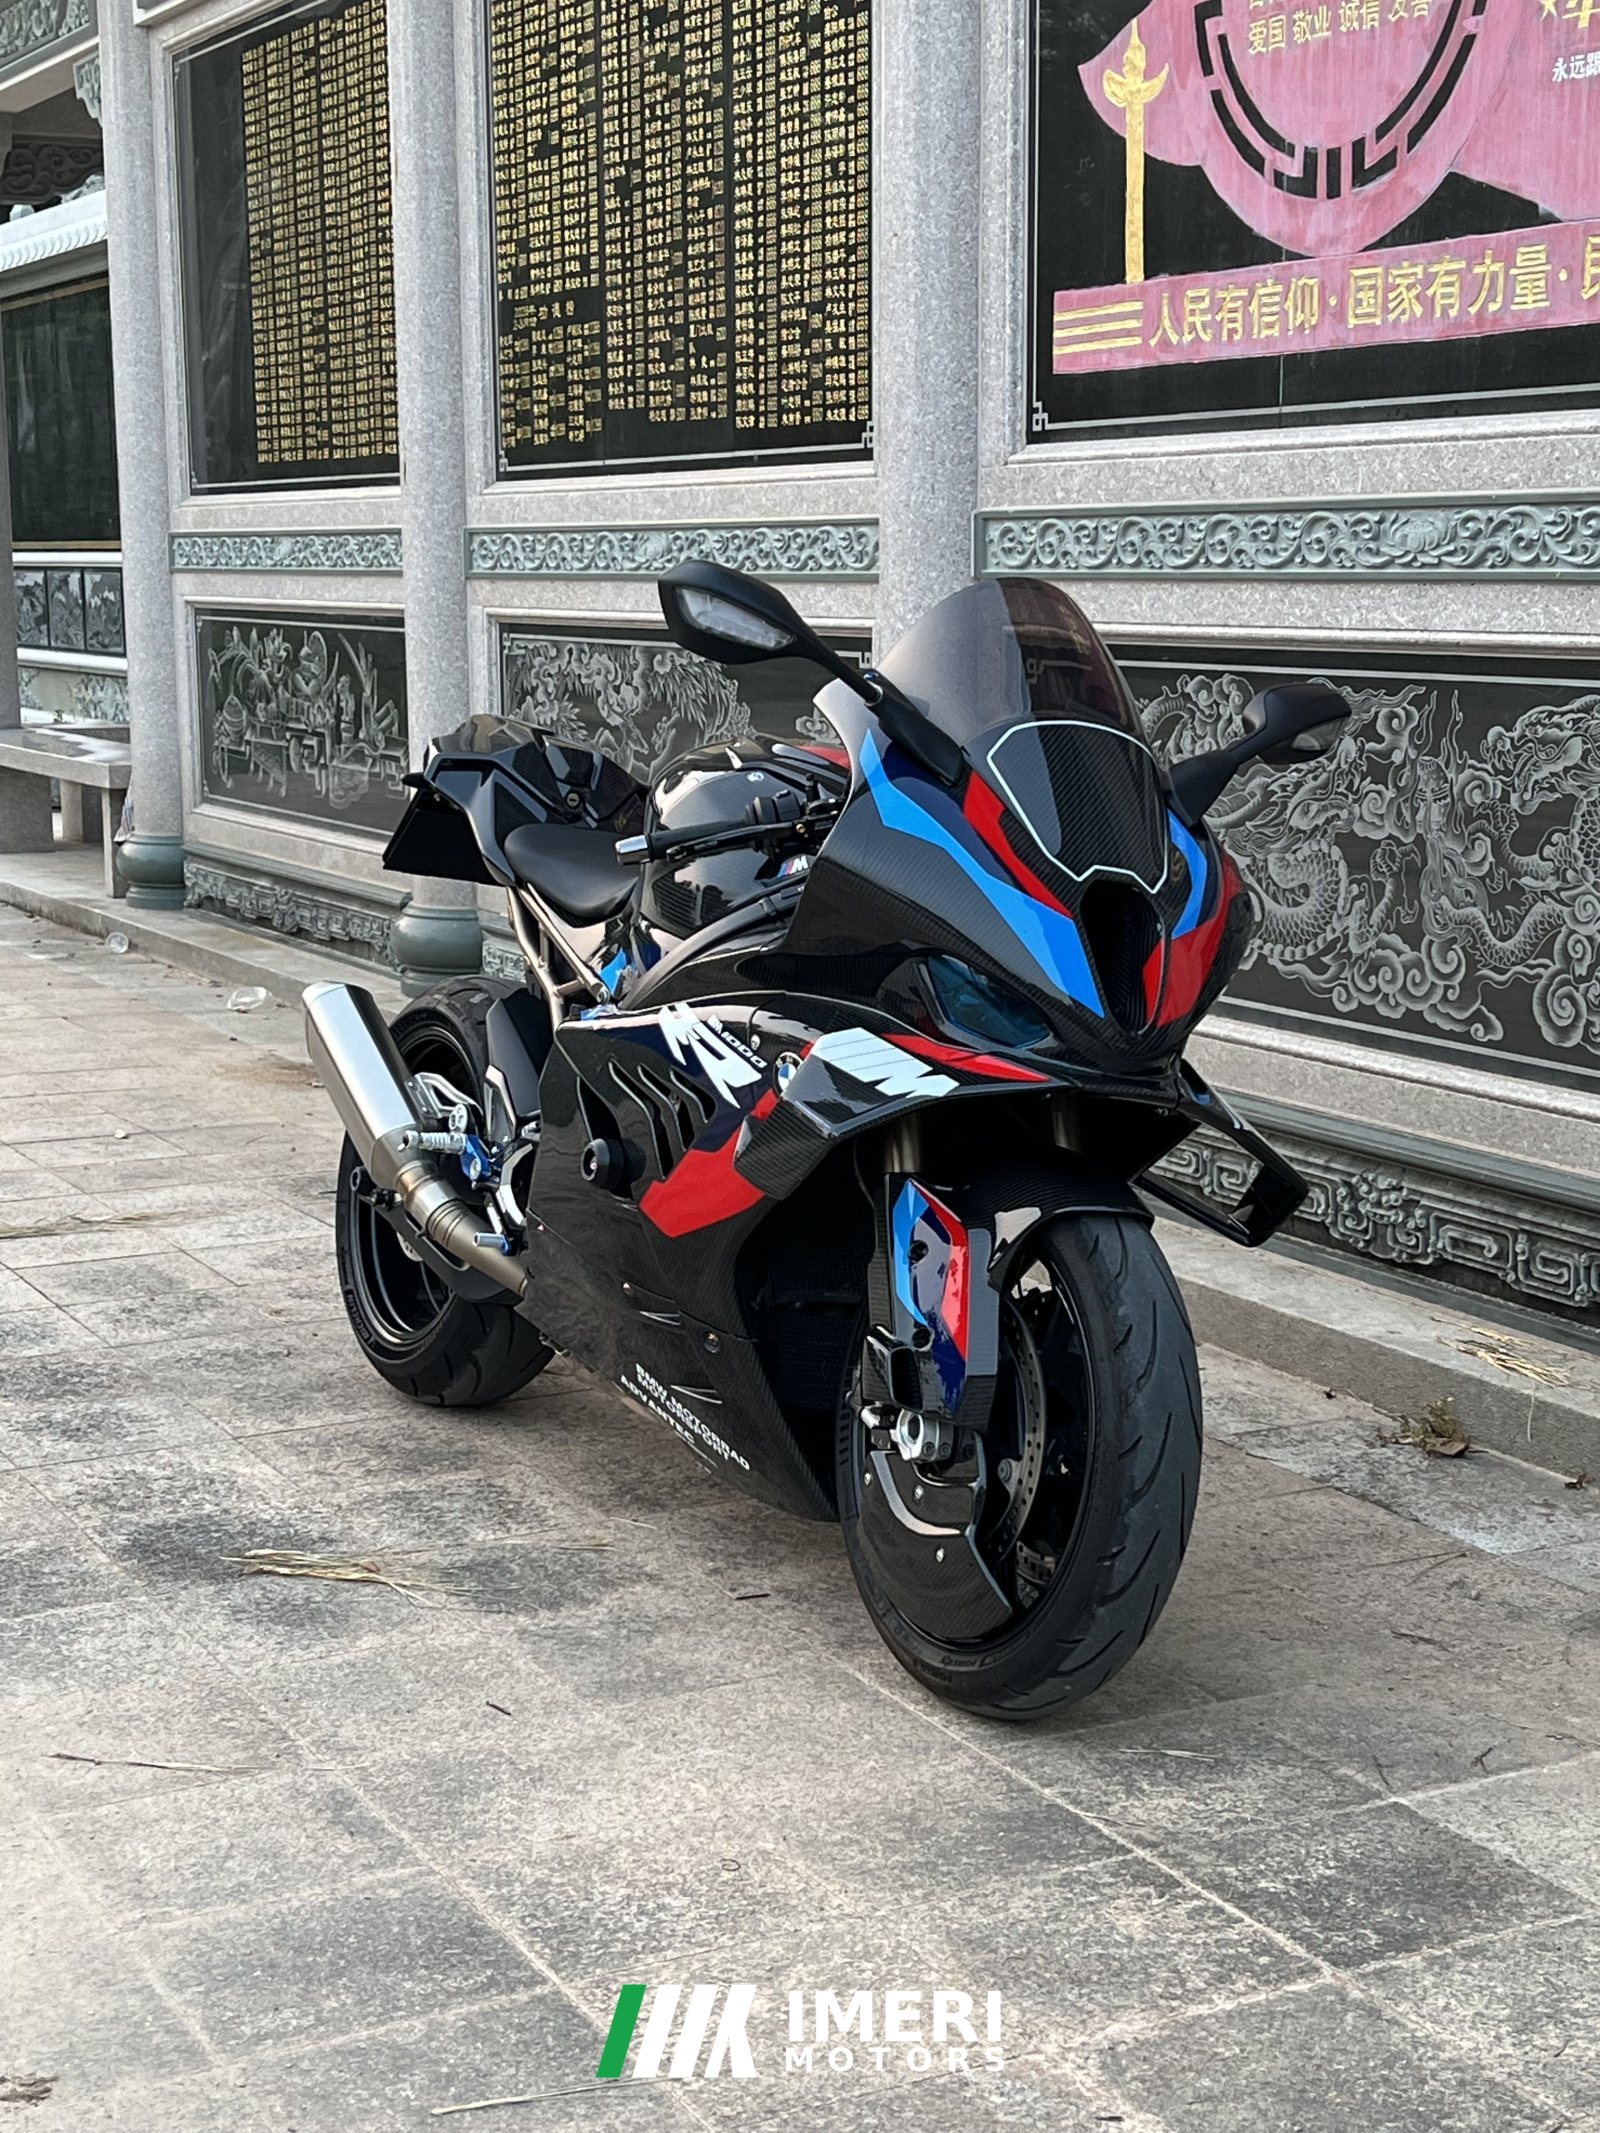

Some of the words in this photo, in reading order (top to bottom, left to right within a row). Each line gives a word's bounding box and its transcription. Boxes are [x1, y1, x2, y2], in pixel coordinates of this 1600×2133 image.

[1248, 15, 1286, 54] 爱国
[1292, 5, 1332, 43] 敬业
[1338, 0, 1380, 32] 诚信
[635, 1362, 668, 1398] BMW
[670, 1396, 750, 1471] MOTORRAD
